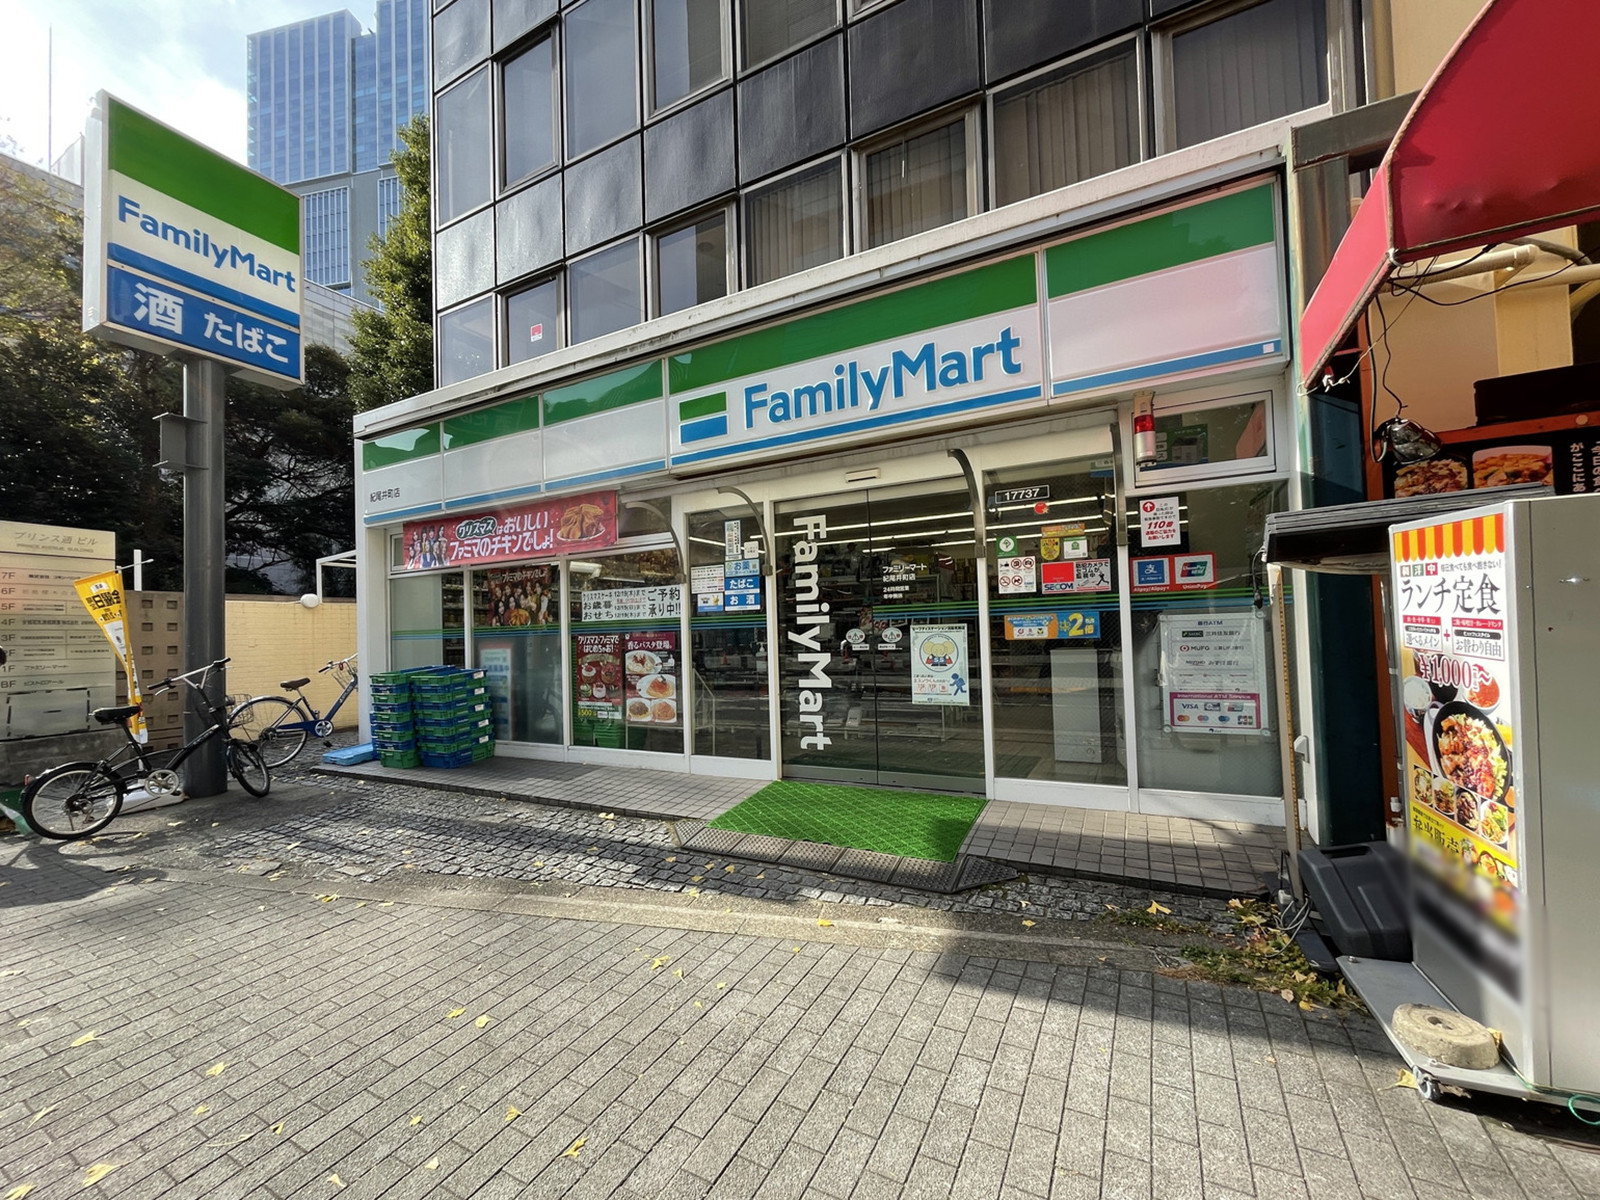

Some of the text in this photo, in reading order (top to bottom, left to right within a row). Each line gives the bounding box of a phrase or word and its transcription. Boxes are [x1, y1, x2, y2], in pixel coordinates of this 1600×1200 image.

[118, 194, 296, 294] FamilyMart
[133, 282, 289, 364] 酒 たばこ
[745, 326, 1022, 430] FamilyMart
[1004, 488, 1040, 501] 17737
[882, 563, 927, 573] ファミリーマート
[1427, 563, 1436, 574] 中
[729, 579, 755, 589] たばこ
[1044, 583, 1074, 591] SECOM
[647, 588, 681, 602] ご予約
[1402, 573, 1501, 615] ランチ定食
[583, 610, 614, 620] おせち
[788, 514, 832, 751] FamilyMart
[1068, 613, 1084, 637] 2
[1456, 639, 1502, 658] お替わり自由
